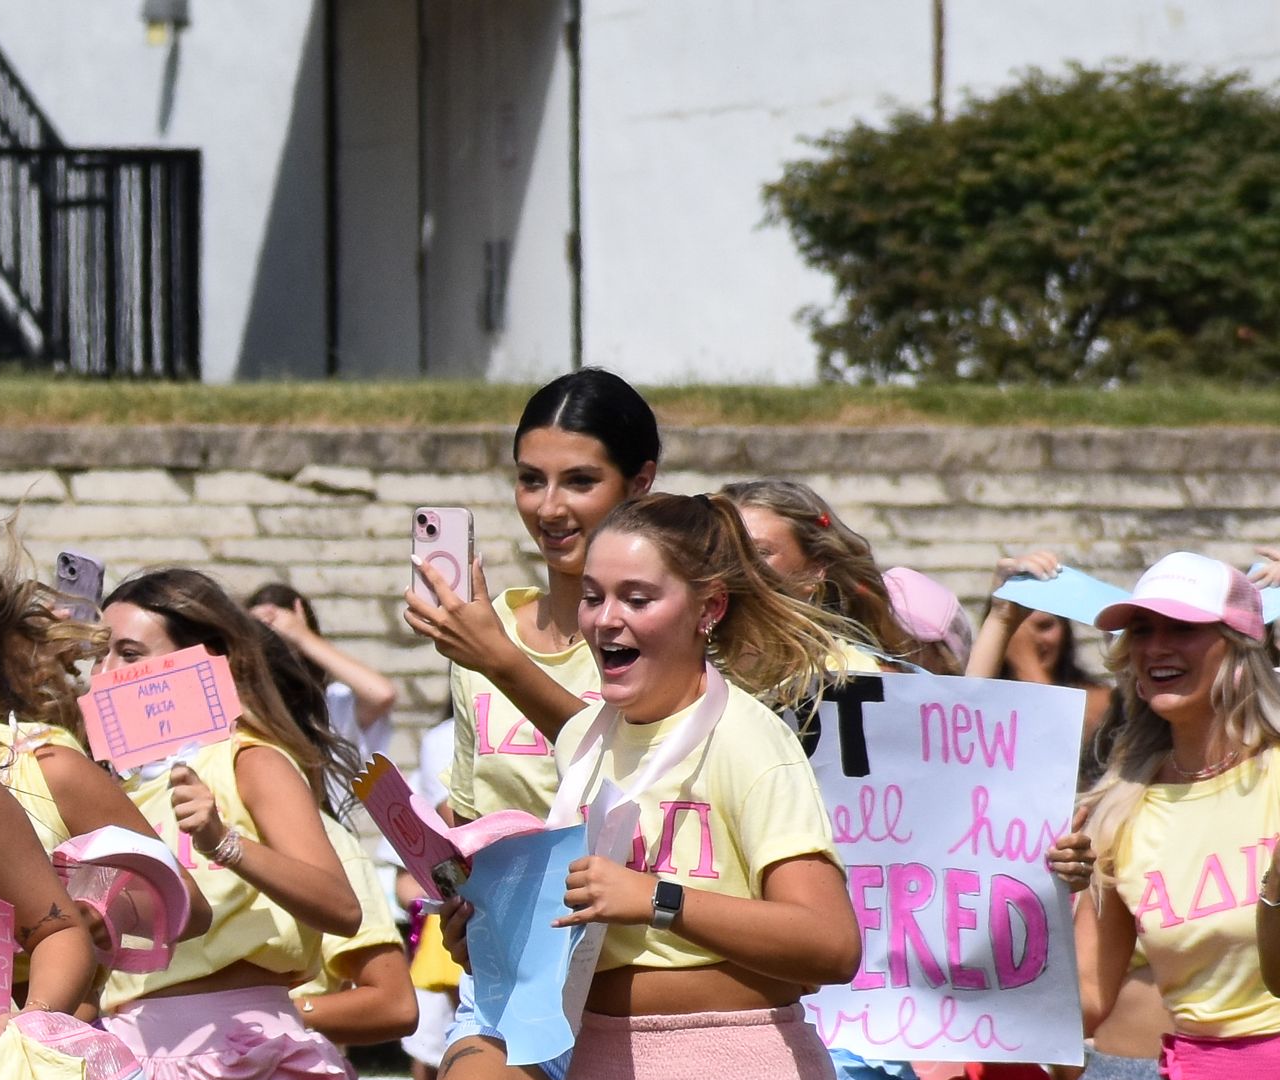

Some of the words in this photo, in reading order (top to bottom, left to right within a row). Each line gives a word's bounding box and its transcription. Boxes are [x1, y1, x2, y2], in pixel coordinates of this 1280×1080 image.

[138, 680, 171, 698] ALPHA
[145, 700, 176, 719] DELTA
[158, 719, 172, 737] PI
[920, 701, 1019, 771] new
[832, 784, 912, 845] ell
[844, 862, 1049, 990] ERED
[806, 996, 1024, 1052] villa
